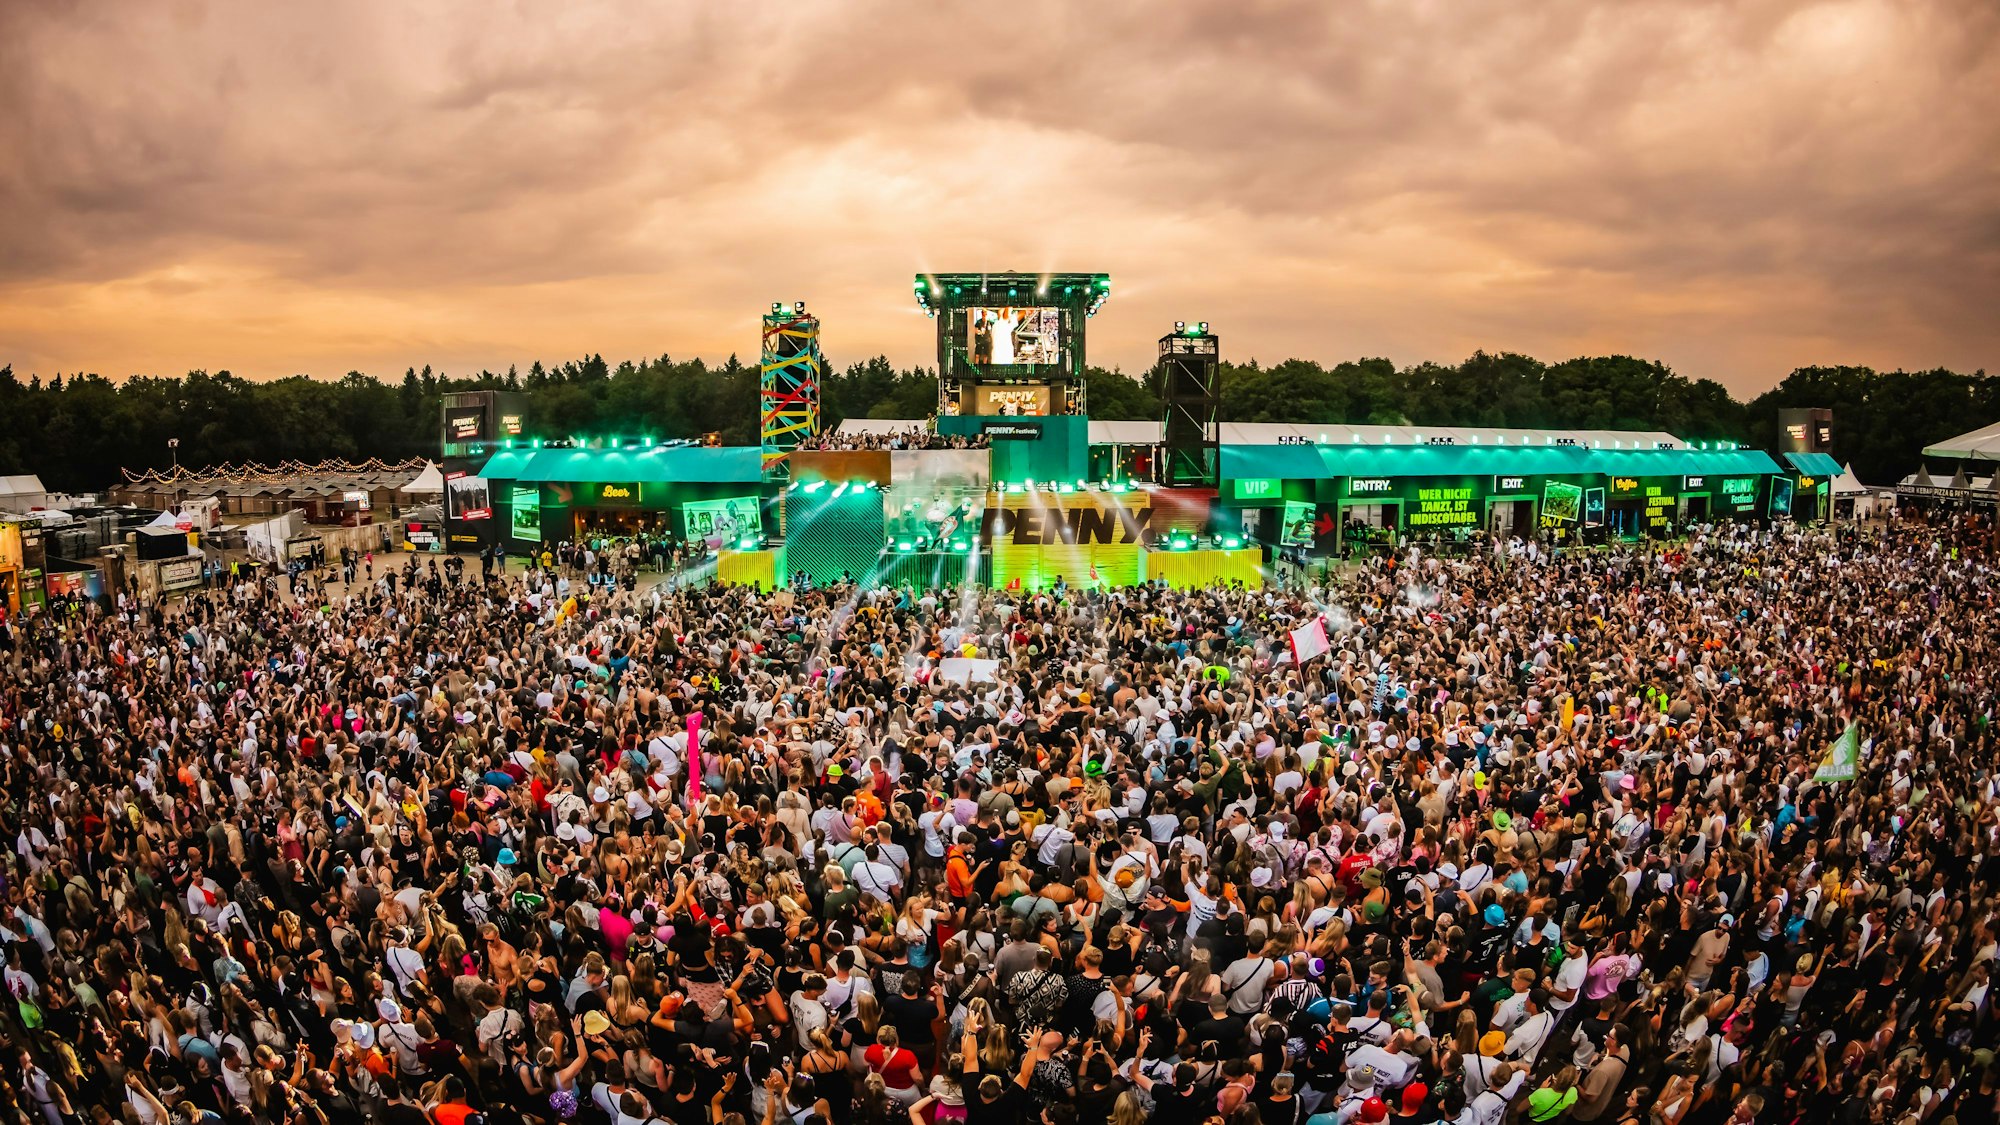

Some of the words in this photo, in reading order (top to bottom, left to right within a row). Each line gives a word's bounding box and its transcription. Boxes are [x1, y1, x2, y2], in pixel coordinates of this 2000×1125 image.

[603, 485, 629, 497] Beer
[1616, 479, 1638, 491] Coffee
[1419, 489, 1442, 500] WER
[1443, 488, 1472, 500] NICHT
[1646, 487, 1661, 496] KEIN
[1934, 488, 1948, 496] PIZZA
[1649, 497, 1675, 506] FESTIVAL
[1731, 493, 1754, 504] Festivals
[1421, 500, 1453, 513] TANZT,
[1455, 500, 1468, 511] IST
[1646, 507, 1663, 517] OHNE
[1410, 512, 1477, 525] INDISCOTABEL
[1540, 516, 1562, 528] 24/7
